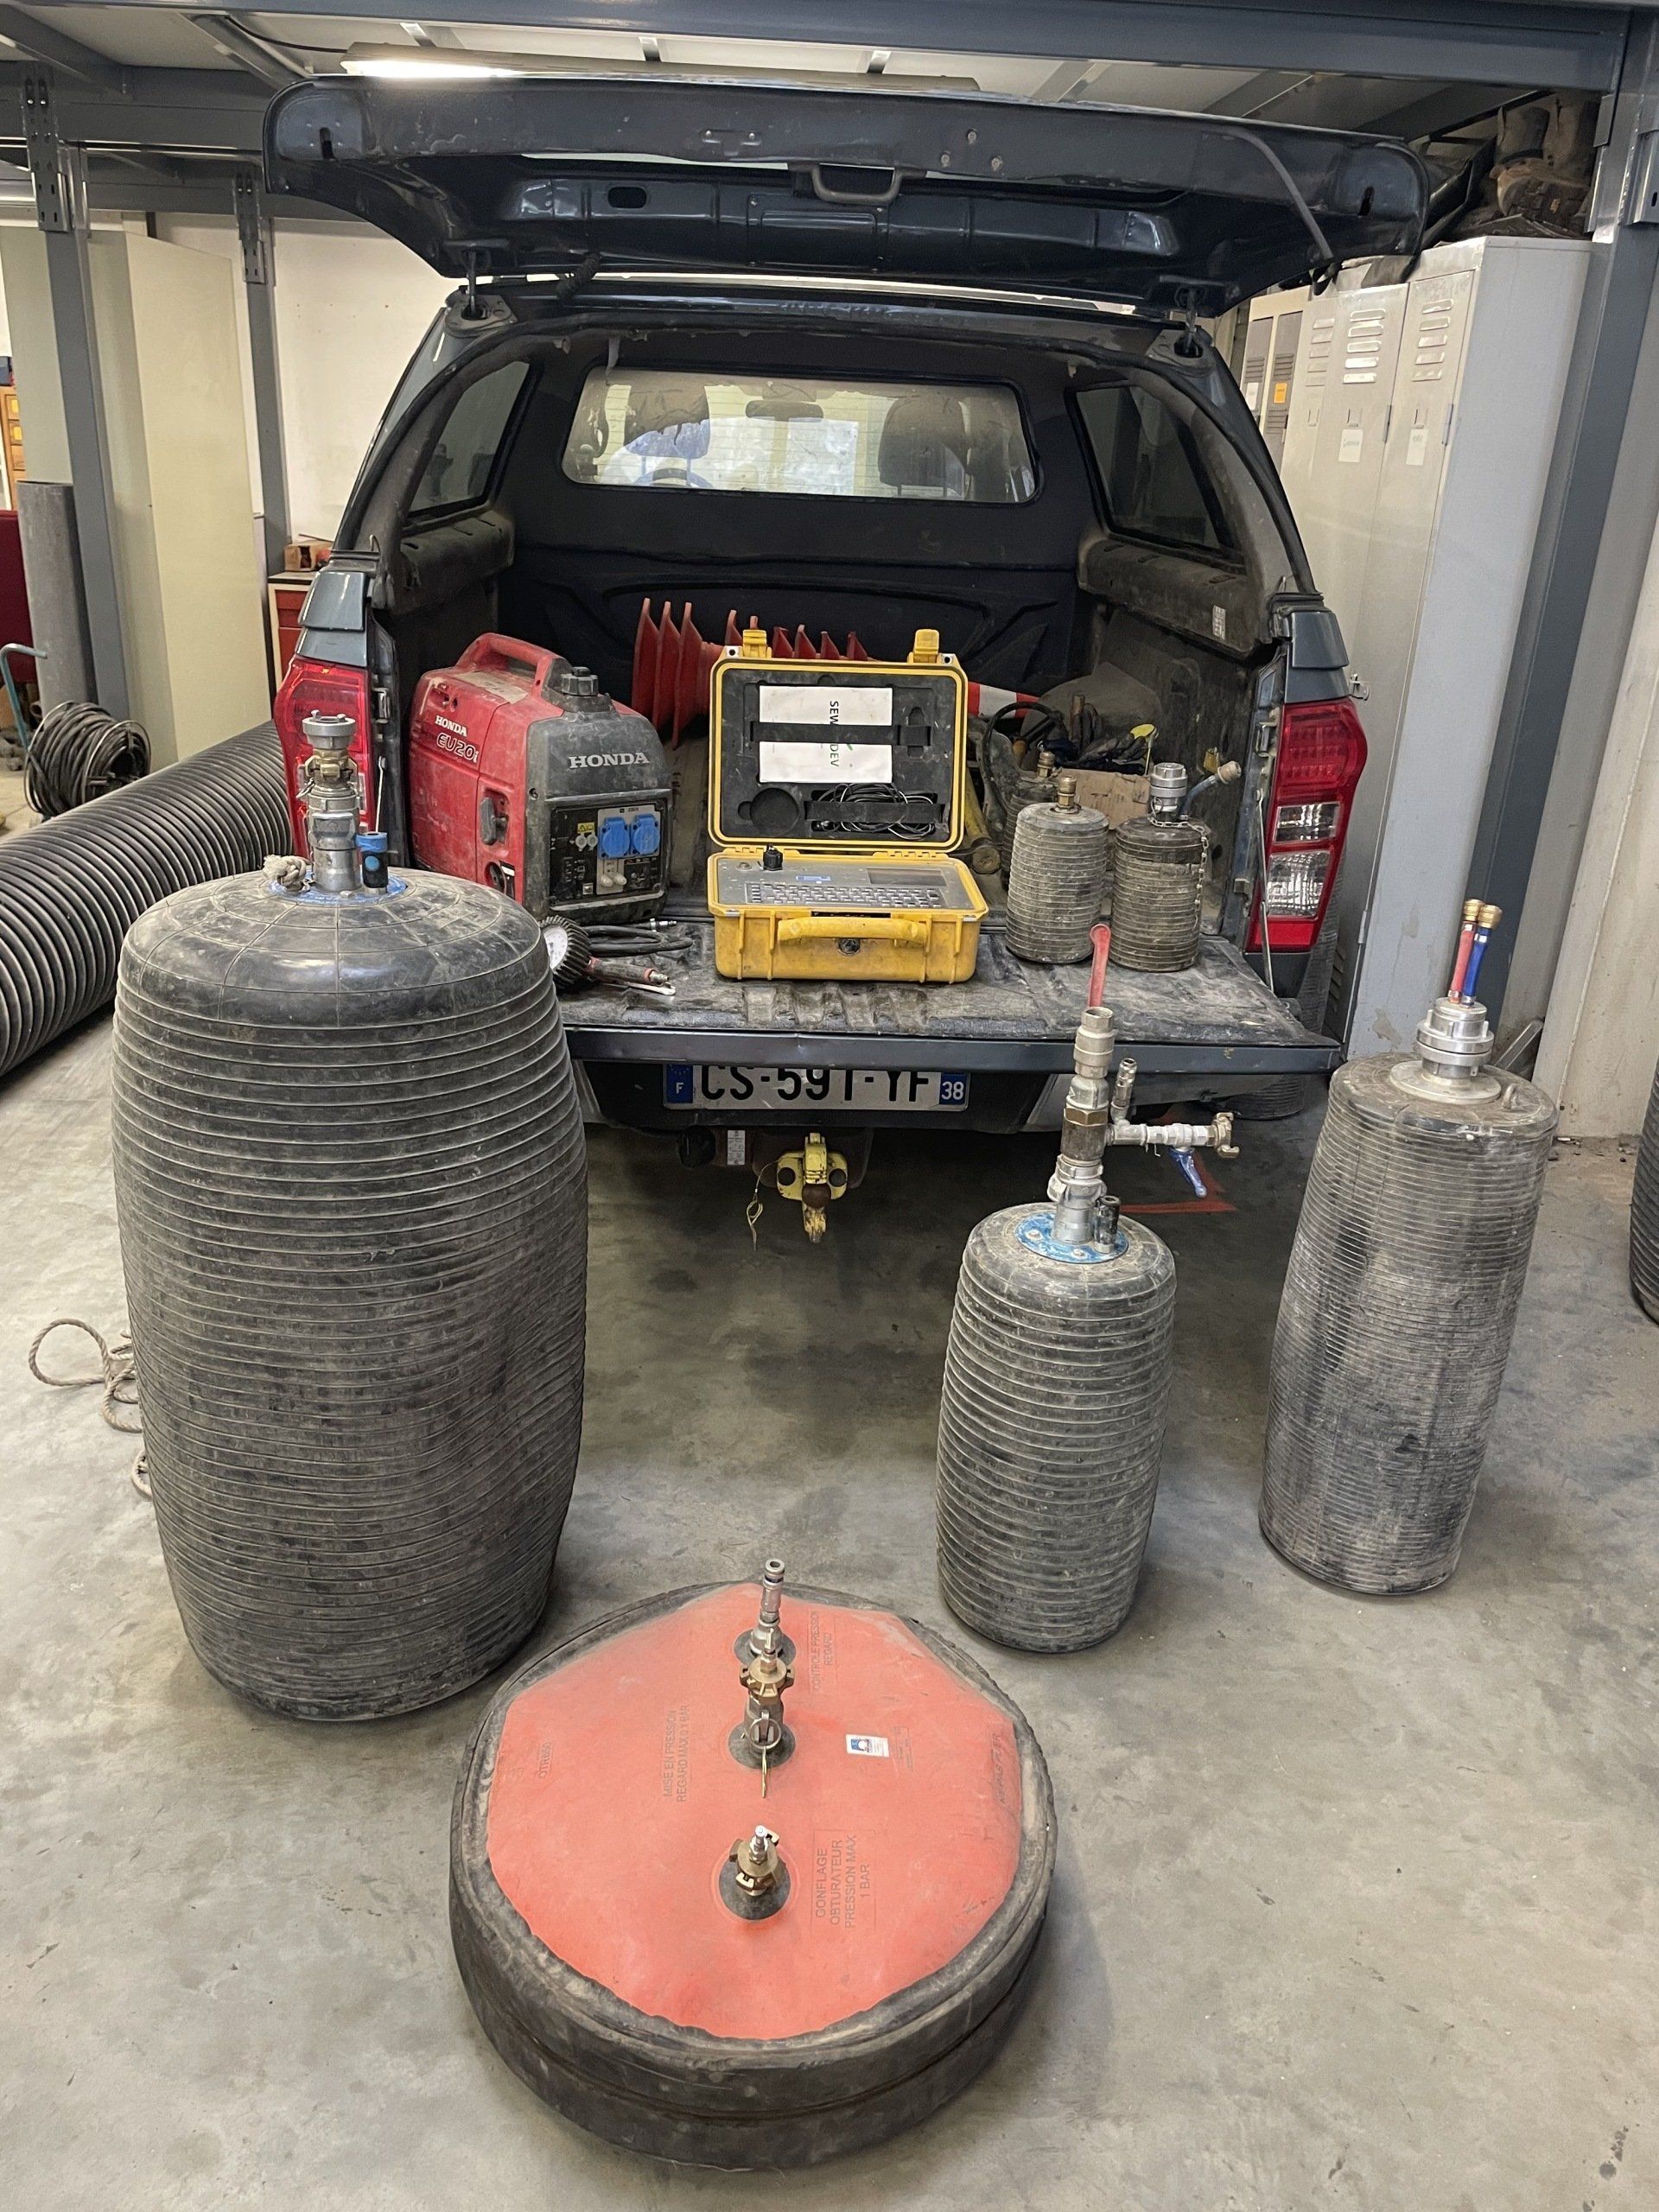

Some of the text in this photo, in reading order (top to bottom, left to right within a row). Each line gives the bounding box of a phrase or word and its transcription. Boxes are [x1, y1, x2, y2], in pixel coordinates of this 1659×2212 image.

[435, 715, 467, 737] HONDA
[436, 732, 480, 763] EU20i
[568, 752, 650, 769] HONDA
[676, 1082, 684, 1094] F
[941, 1081, 964, 1100] 38
[664, 1756, 675, 1770] EN
[662, 1772, 674, 1797] MISE
[677, 1759, 688, 1802] REGARD
[815, 1847, 827, 1918] GONFLAGE
[830, 1840, 842, 1925] OBTURATEUR
[844, 1834, 856, 1929] PRESSION MAX
[859, 1864, 870, 1889] BAR
